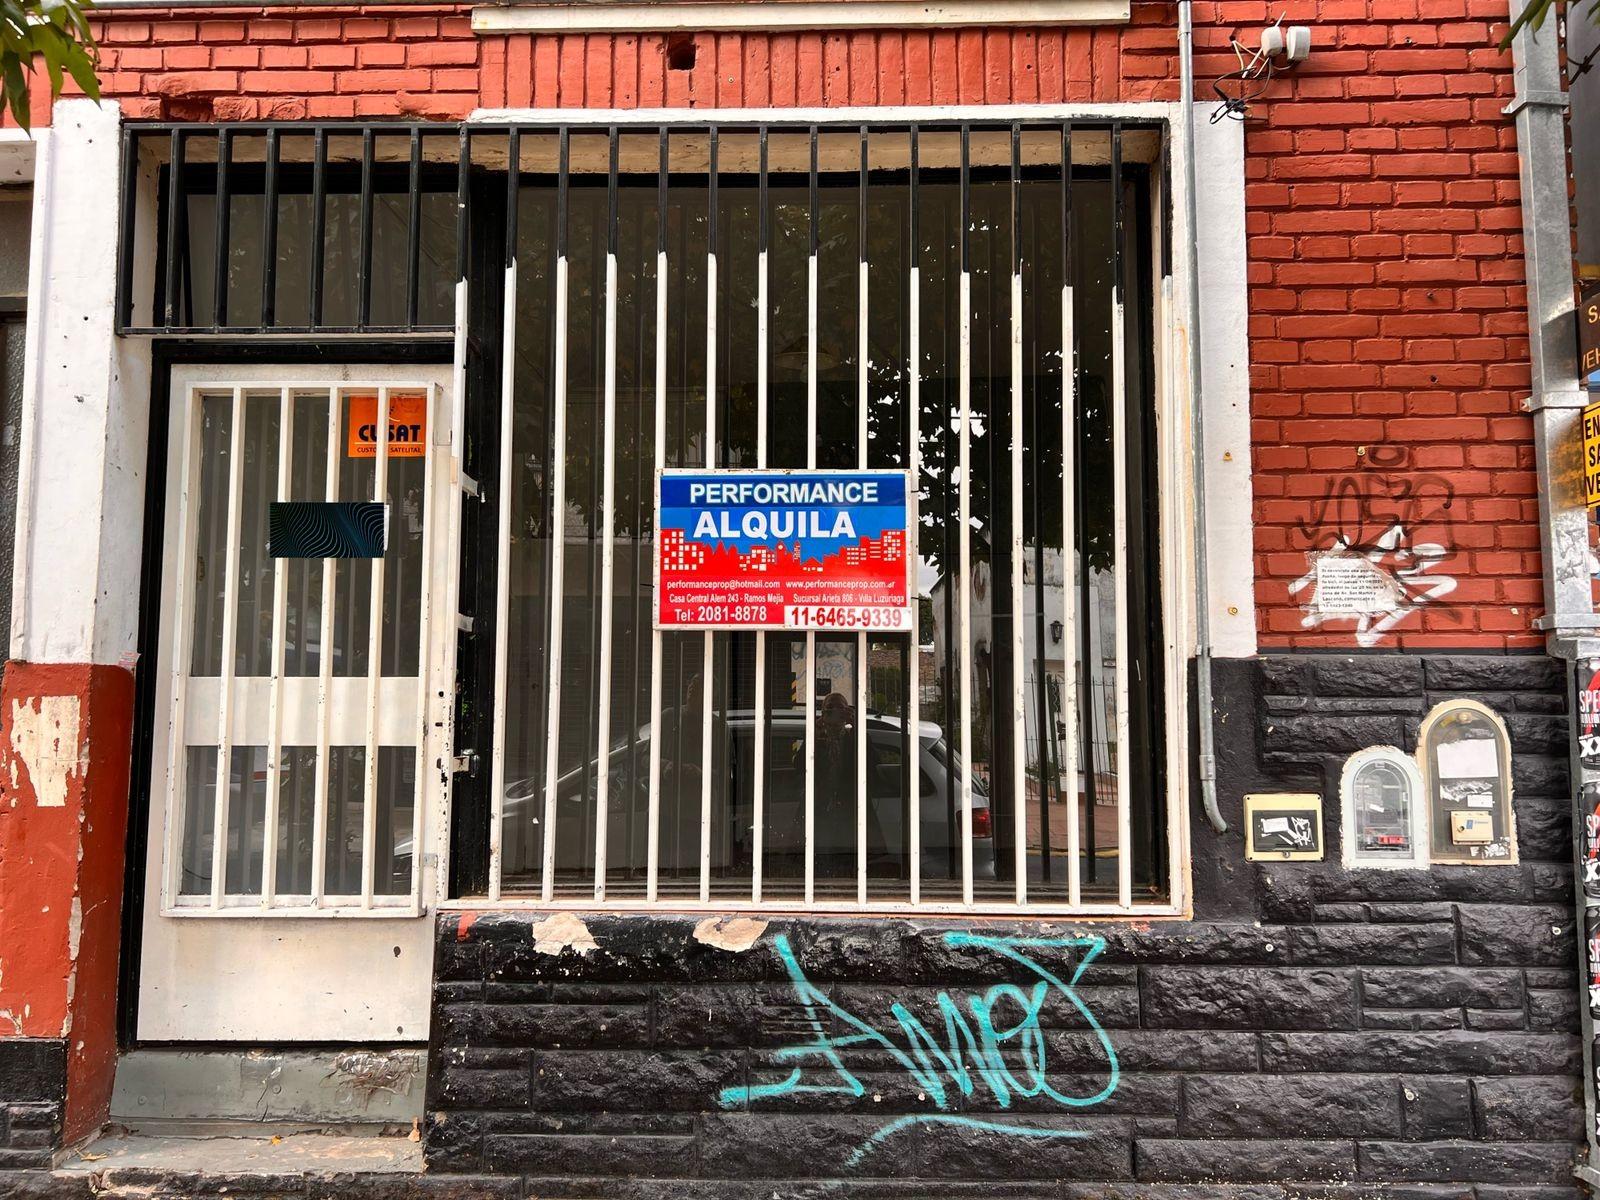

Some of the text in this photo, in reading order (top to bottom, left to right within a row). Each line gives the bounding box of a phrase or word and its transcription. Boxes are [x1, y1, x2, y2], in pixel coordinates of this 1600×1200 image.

[690, 482, 878, 504] PERFORMANCE
[693, 511, 857, 540] ALQUILA
[667, 580, 895, 590] performanceprop@hotmail.com www.performanceprop.com.ar
[669, 594, 685, 603] Casa
[686, 594, 709, 603] Central
[710, 594, 727, 603] Alem
[727, 594, 739, 602] 243
[744, 593, 765, 603] Ramos
[793, 593, 820, 603] Sucursal
[858, 593, 872, 603] Villa
[873, 593, 905, 604] Luzuriaga
[674, 606, 767, 621] Tel: 2081-8878
[792, 607, 902, 627] 11-6465-9339
